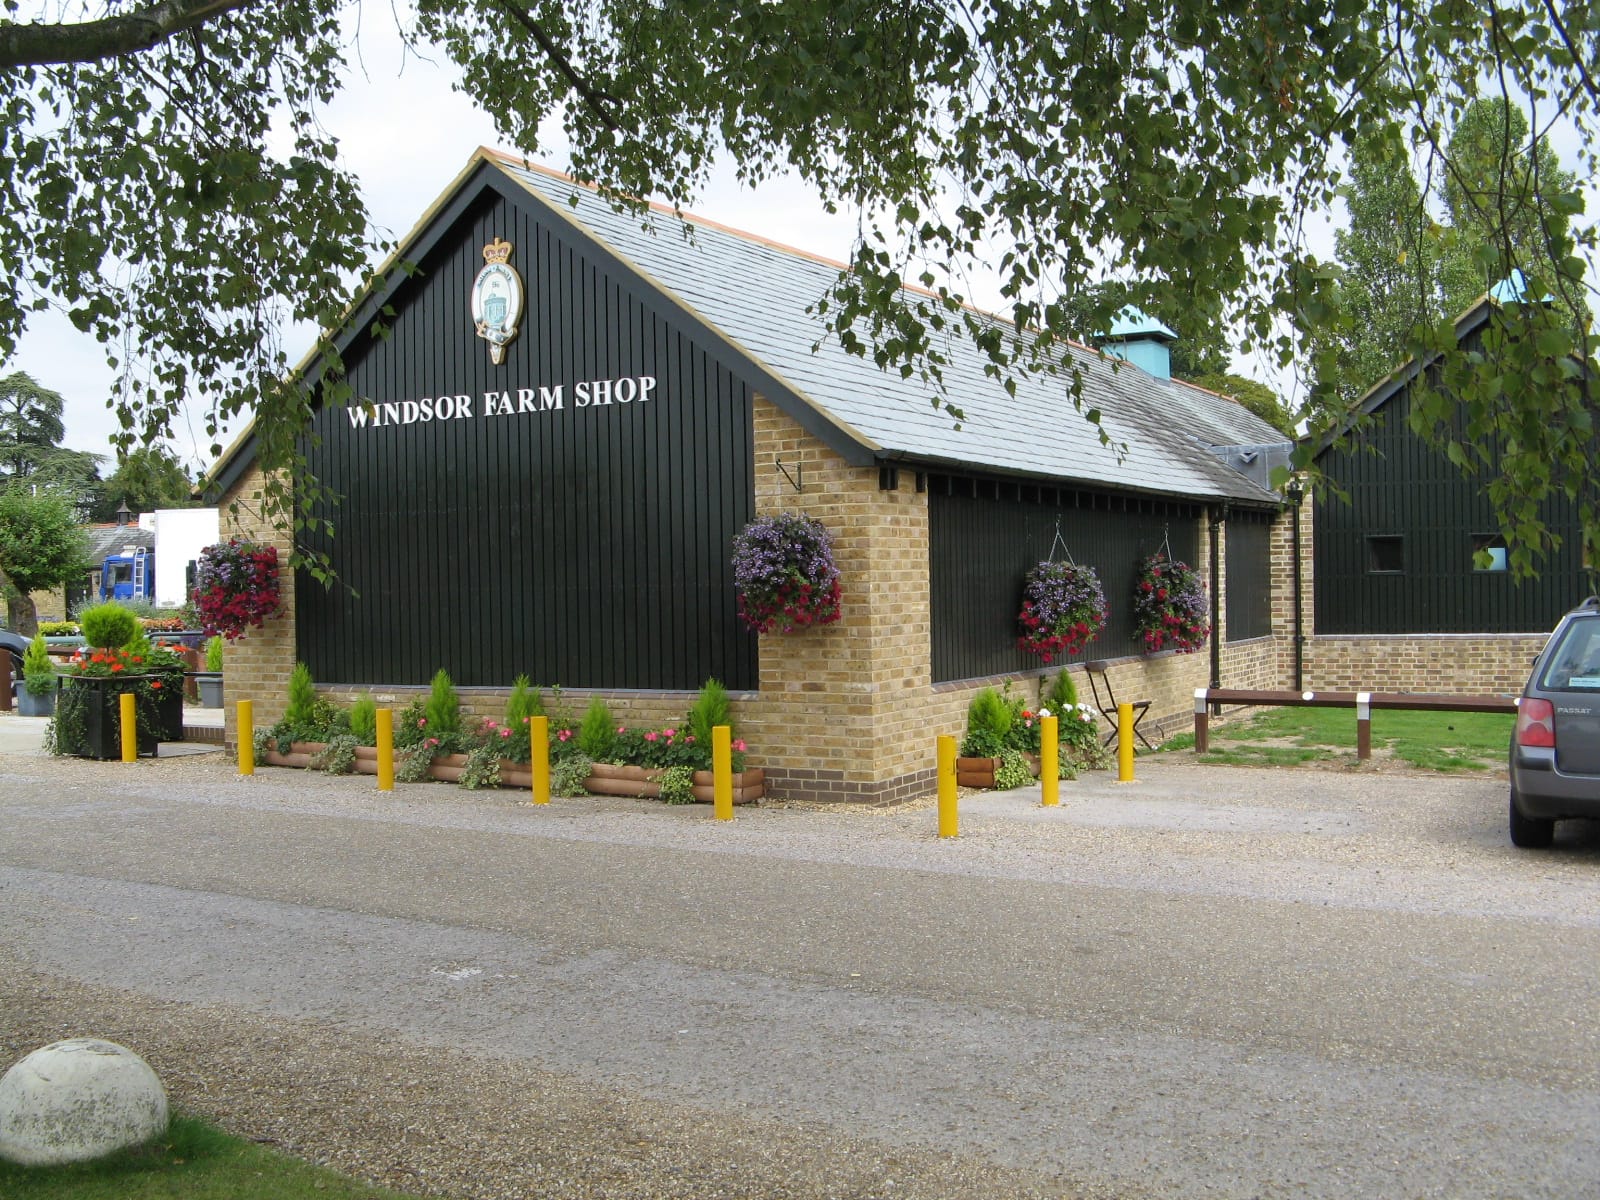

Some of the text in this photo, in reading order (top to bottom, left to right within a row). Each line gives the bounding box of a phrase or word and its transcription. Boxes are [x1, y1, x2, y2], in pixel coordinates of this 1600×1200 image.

[347, 376, 656, 429] WINDSOR FARM SHOP
